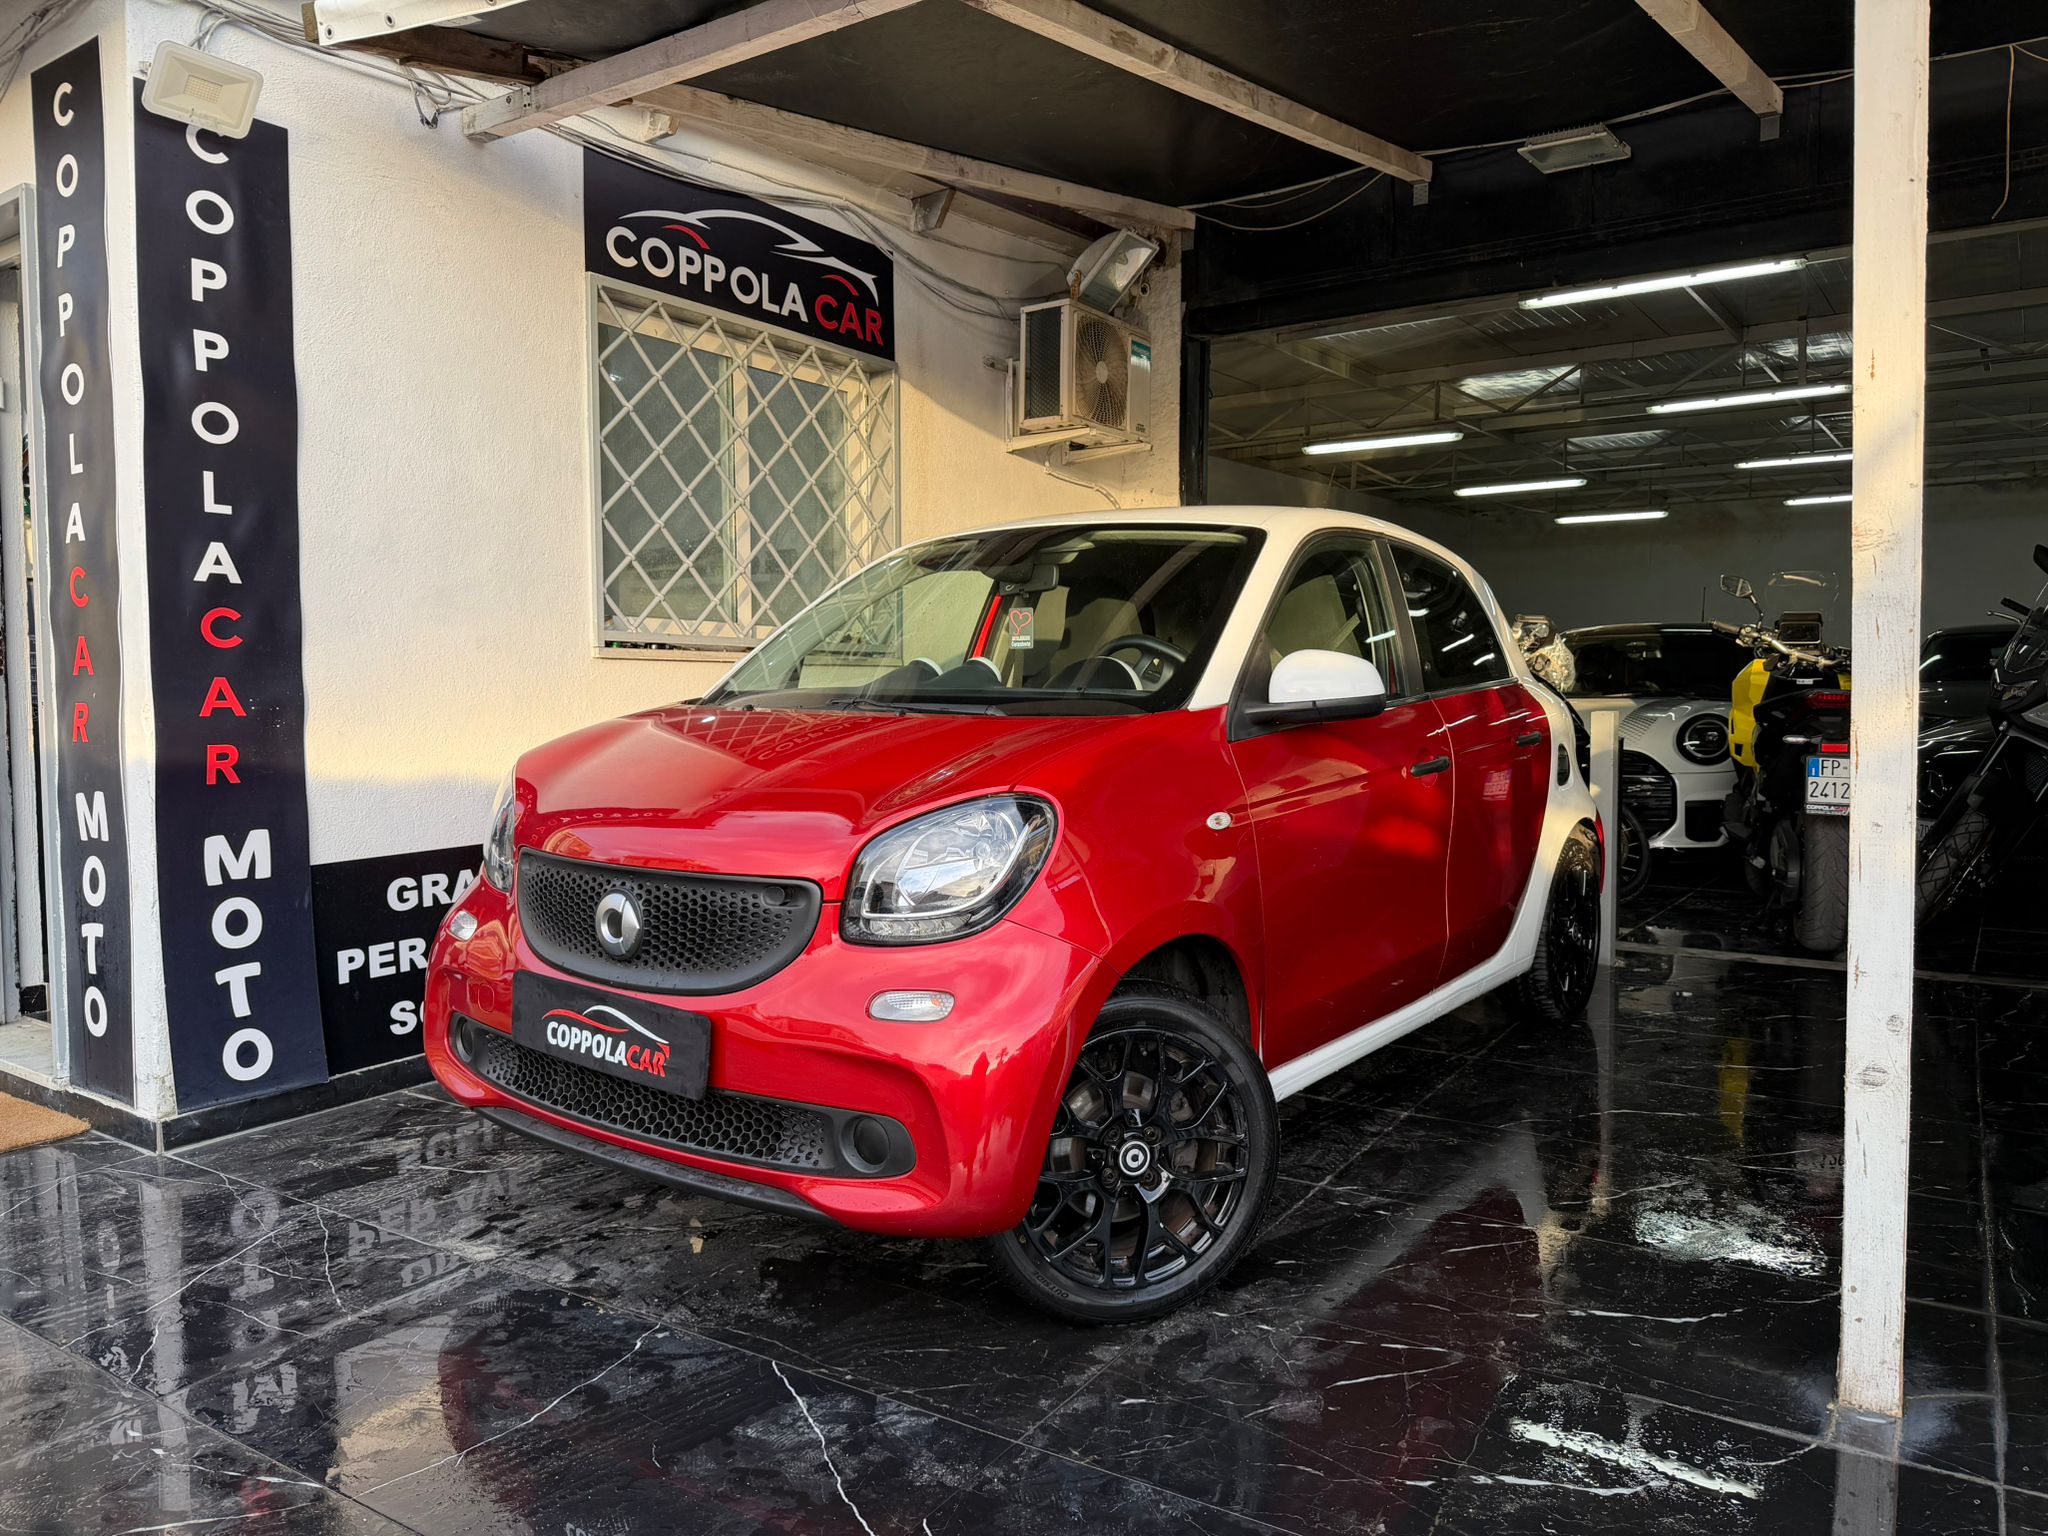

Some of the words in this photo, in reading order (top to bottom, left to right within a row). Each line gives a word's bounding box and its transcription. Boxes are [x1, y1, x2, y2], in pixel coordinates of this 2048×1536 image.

[75, 790, 110, 1039] MOTO
[203, 828, 275, 1083] MOTO
[336, 936, 428, 985] PER
[389, 1000, 425, 1036] S
